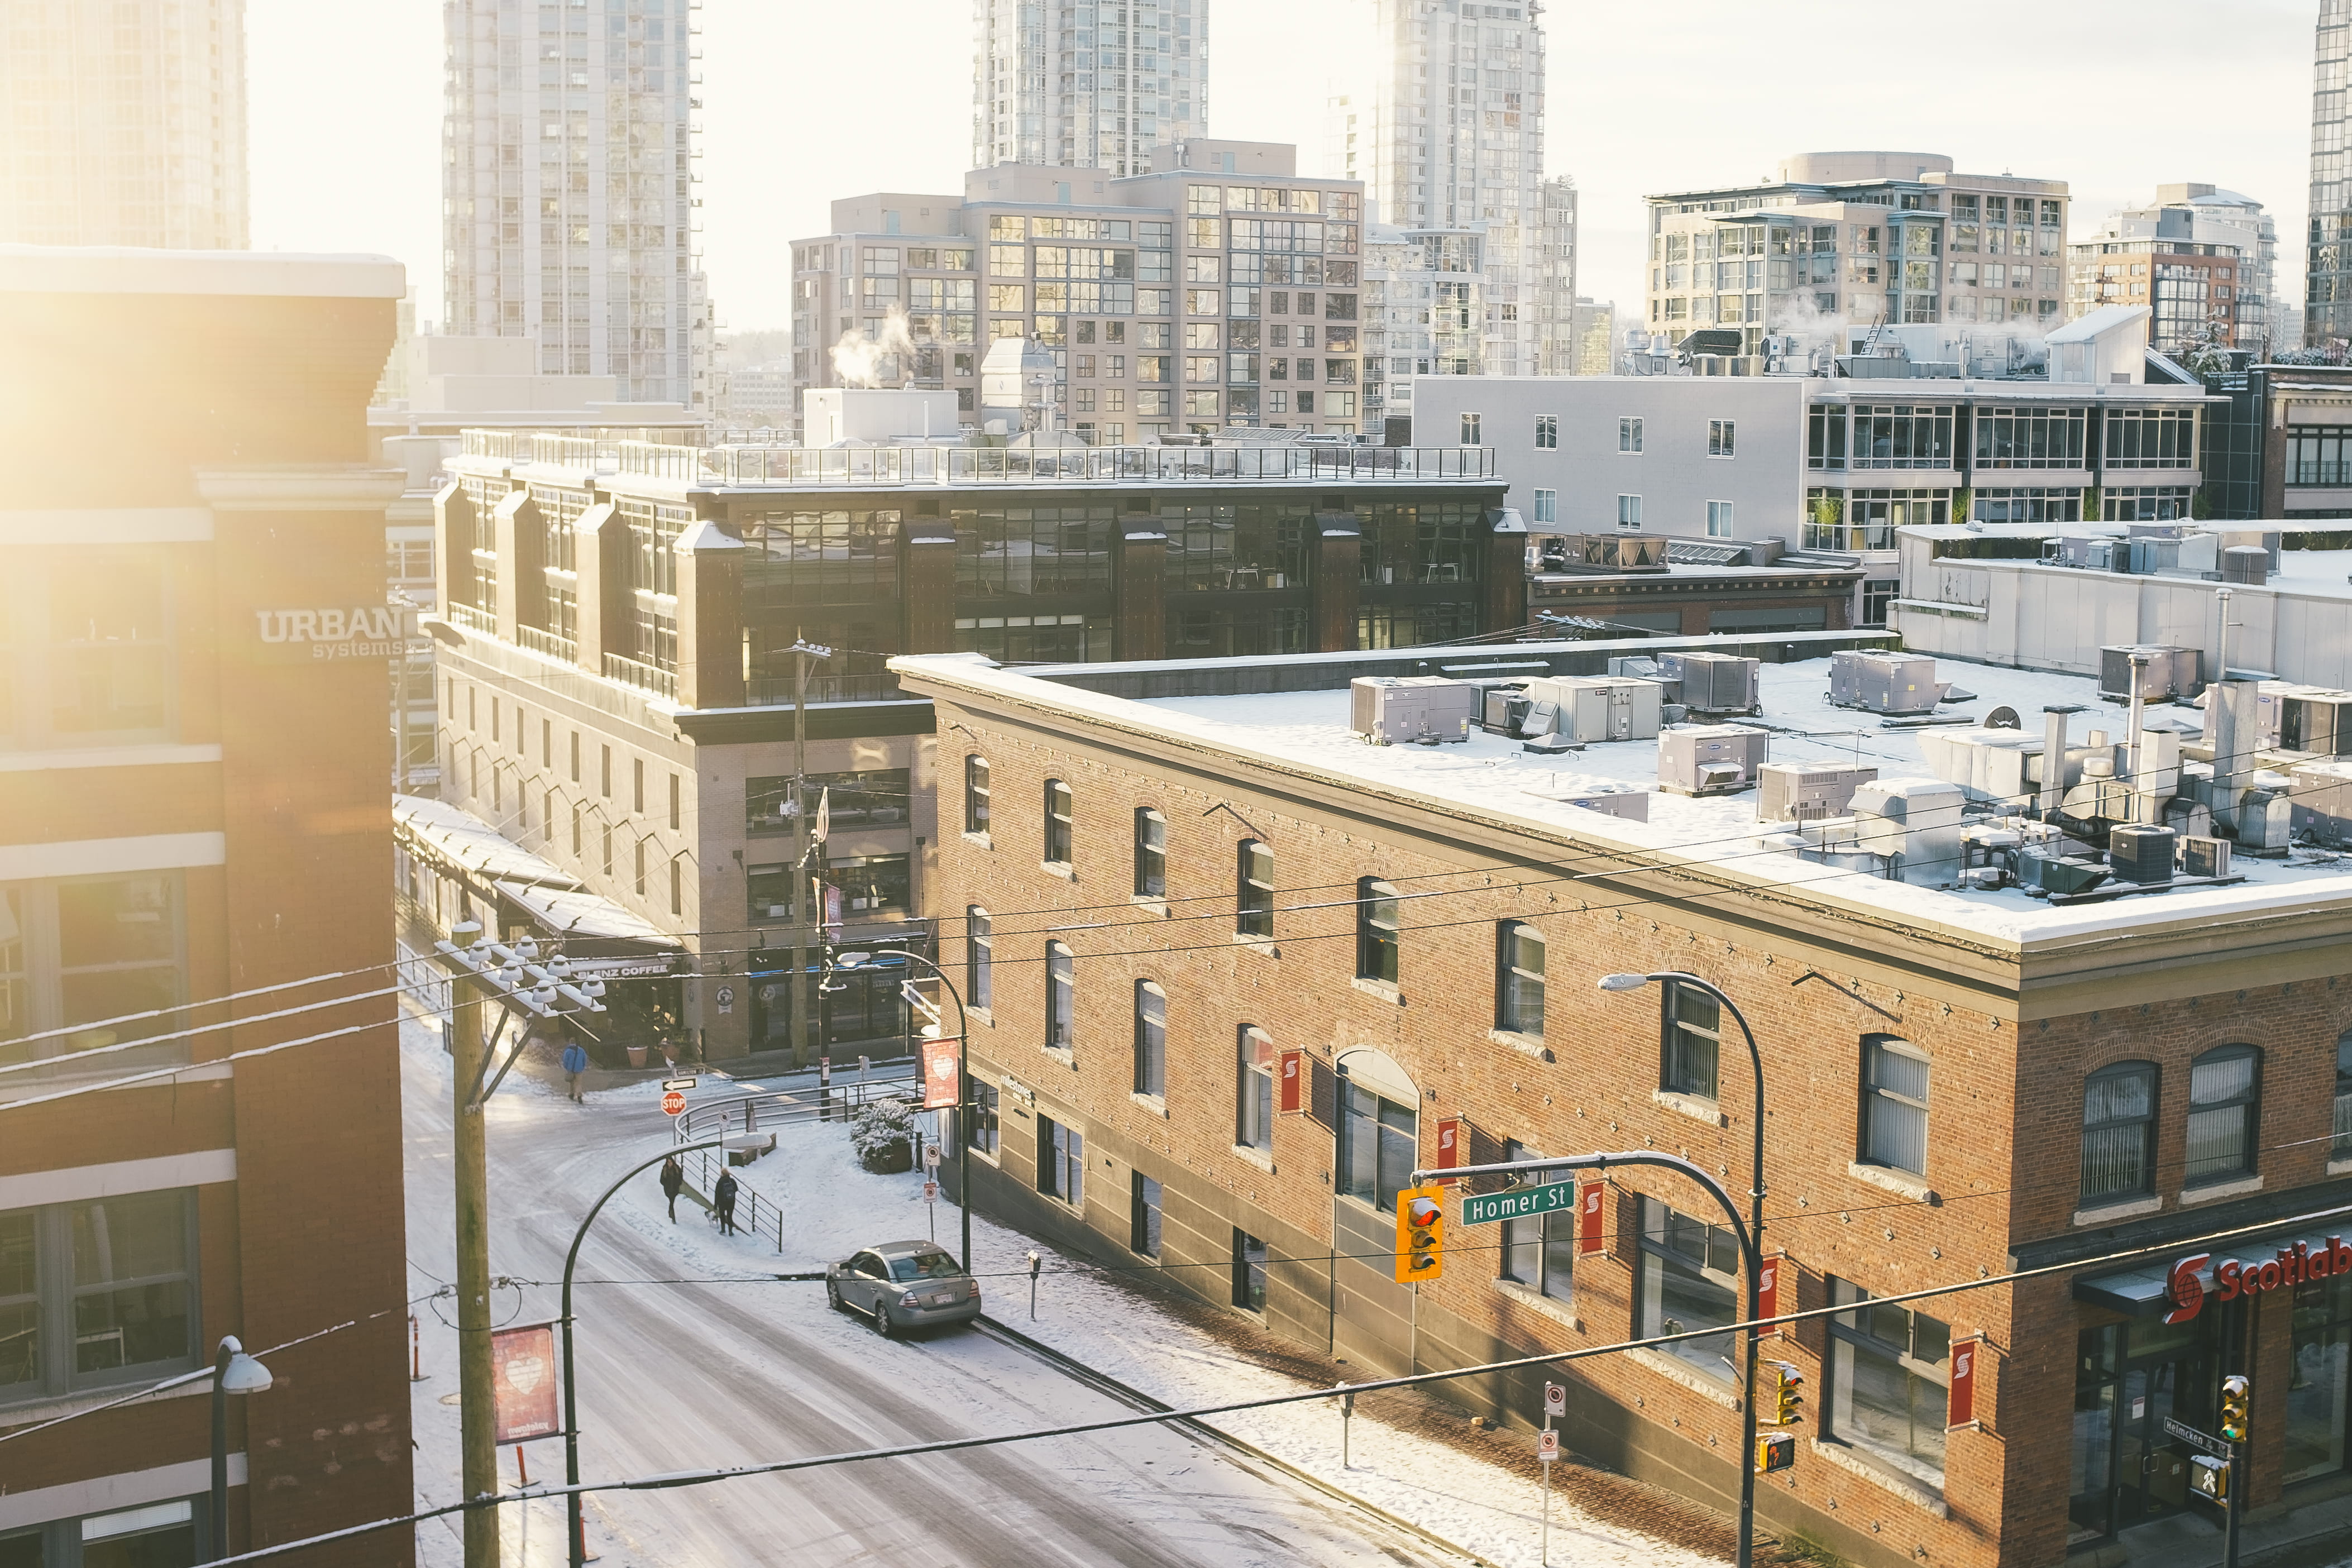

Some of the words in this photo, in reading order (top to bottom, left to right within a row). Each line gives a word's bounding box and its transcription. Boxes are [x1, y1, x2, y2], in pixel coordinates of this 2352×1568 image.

[256, 607, 403, 643] URBAN
[313, 640, 403, 661] systems
[621, 965, 668, 977] COFFEE
[1001, 1075, 1031, 1099] milestones
[663, 1098, 685, 1109] STOP
[1473, 1194, 1539, 1220] Homer
[1548, 1186, 1566, 1207] St
[2166, 1420, 2203, 1445] Helmcken
